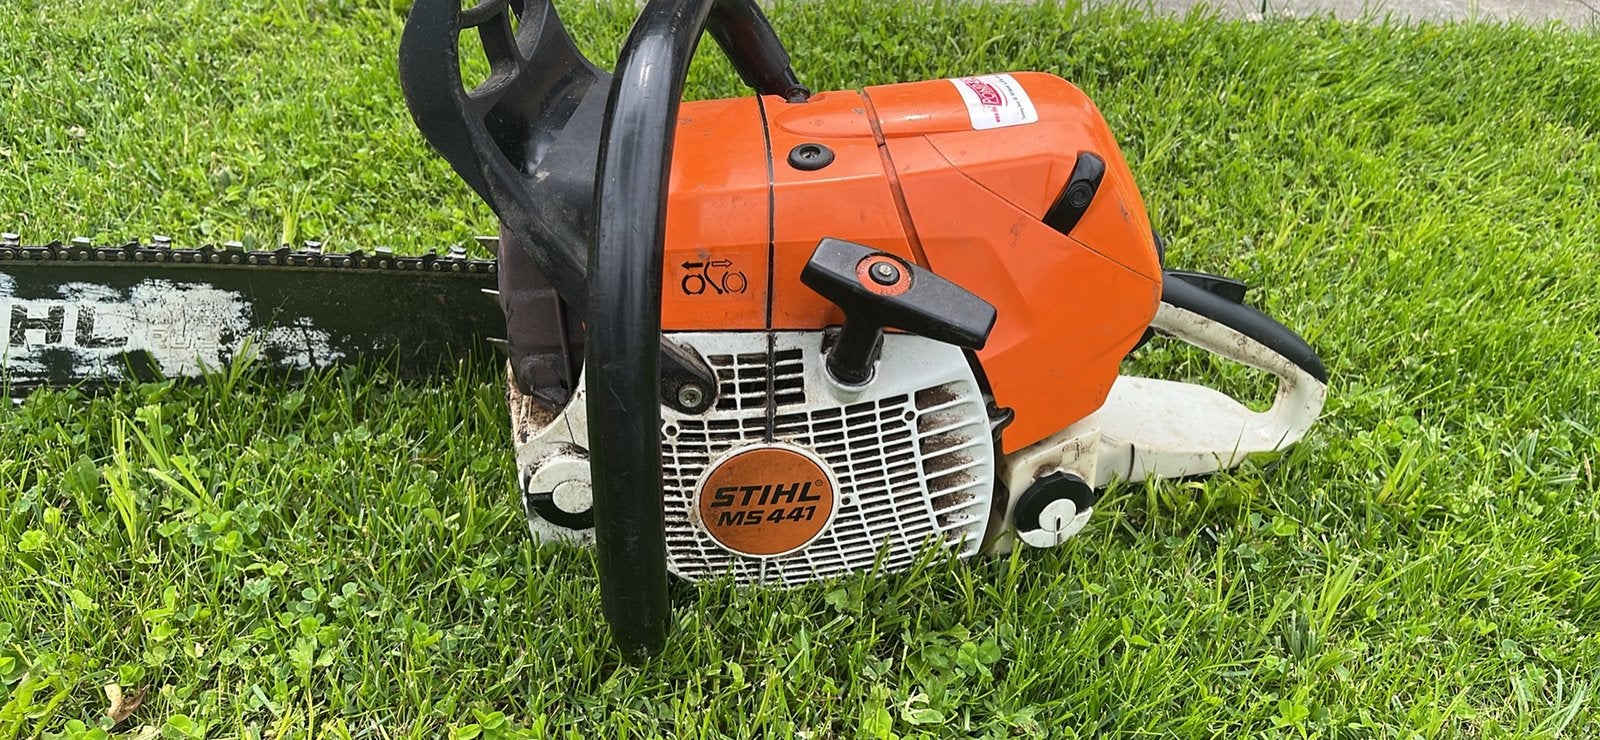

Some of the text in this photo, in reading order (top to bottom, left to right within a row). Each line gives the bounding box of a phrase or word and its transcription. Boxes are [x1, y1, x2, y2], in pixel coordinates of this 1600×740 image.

[711, 481, 821, 508] STIHL
[717, 505, 817, 527] MS 441
